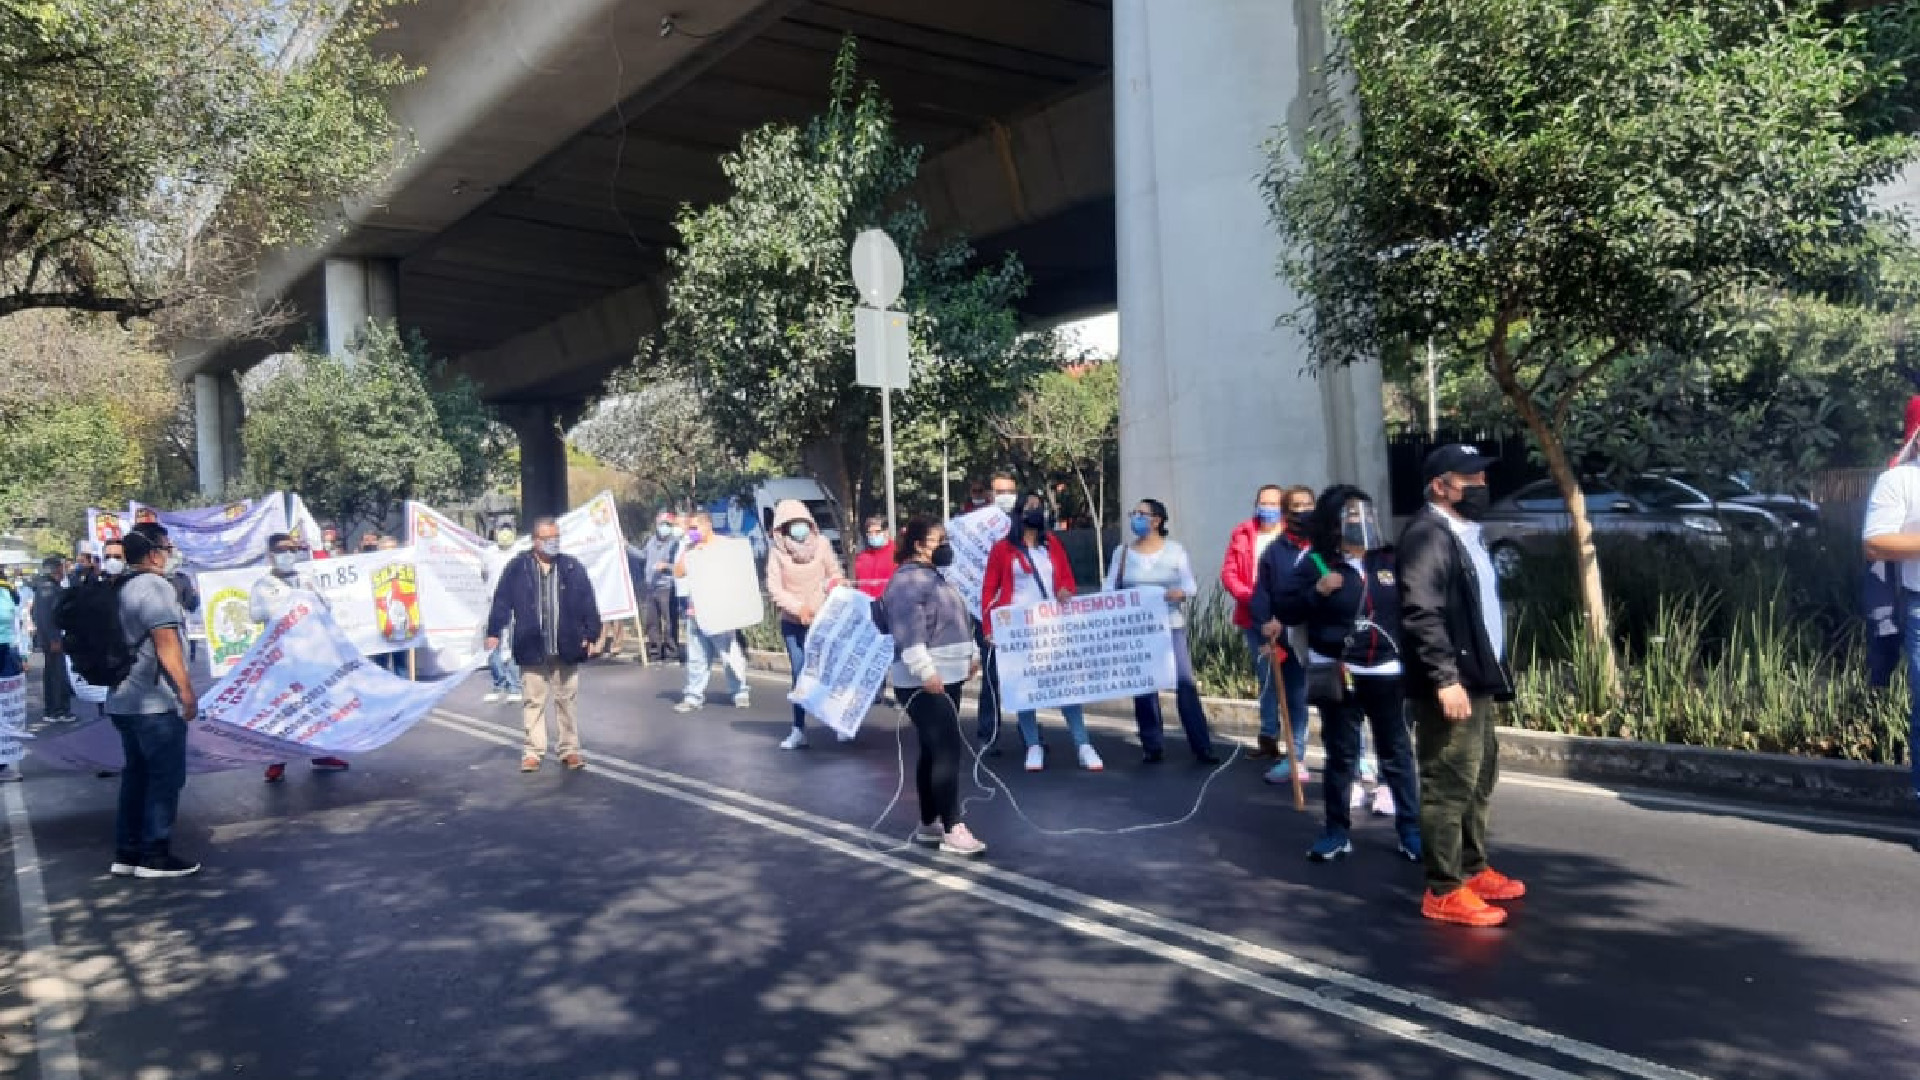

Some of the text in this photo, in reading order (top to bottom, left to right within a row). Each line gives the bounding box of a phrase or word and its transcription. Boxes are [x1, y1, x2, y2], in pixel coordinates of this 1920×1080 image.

[336, 564, 359, 586] 85
[1039, 593, 1126, 617] QUEREMOS
[1051, 616, 1111, 635] LUCHANDO
[1112, 614, 1126, 626] EN
[1127, 611, 1154, 625] ESTA
[1050, 632, 1096, 648] CONTRA
[1082, 641, 1111, 657] PERO
[1129, 637, 1144, 650] LO
[1023, 657, 1099, 677] LOGRAREMOS
[1120, 665, 1141, 678] LOS
[1027, 684, 1086, 703] SOLDADOS
[1119, 675, 1155, 690] SALUD
